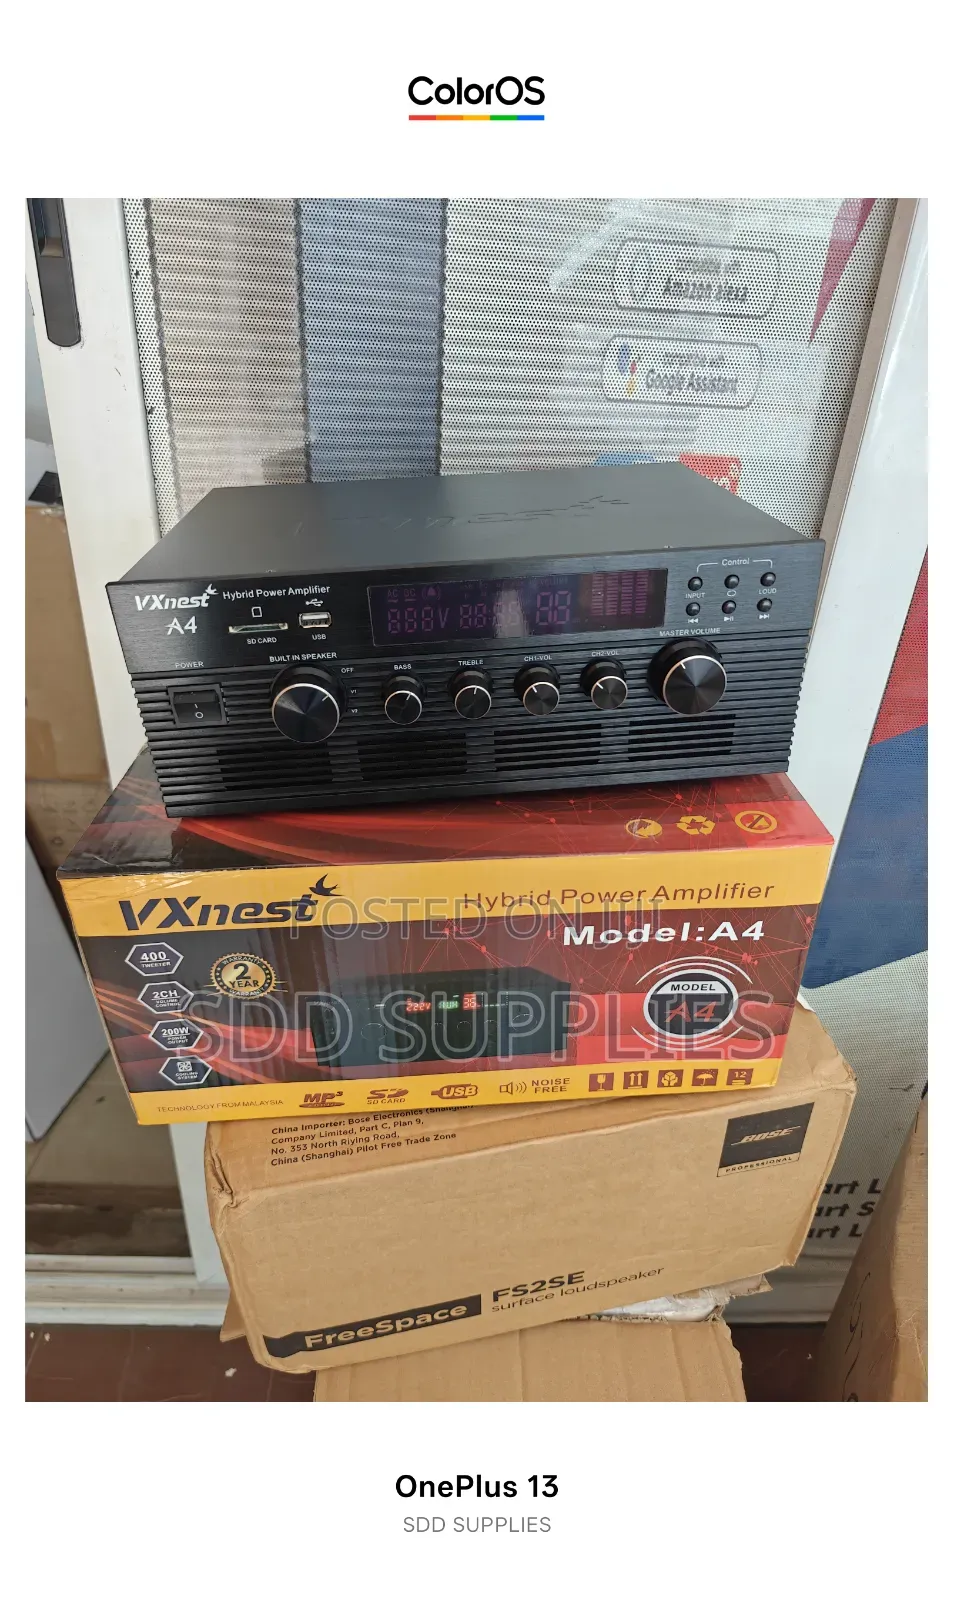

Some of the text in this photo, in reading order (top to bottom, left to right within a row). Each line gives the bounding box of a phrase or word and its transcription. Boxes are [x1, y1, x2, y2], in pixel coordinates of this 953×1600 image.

[645, 368, 738, 395] Google Assistant
[722, 558, 750, 566] Control
[222, 585, 330, 601] Hybrid Power Amplifier
[135, 593, 210, 610] VXnest
[165, 615, 198, 635] A4
[660, 627, 721, 637] MASTER VOLUME
[175, 661, 204, 669] POWER
[269, 655, 291, 663] BUILT
[302, 652, 338, 660] SPEAKER
[464, 883, 774, 912] Hybrid Power Amplifier
[119, 894, 318, 931] VXnest
[141, 951, 167, 961] 400
[222, 956, 261, 965] WARRANTY
[233, 962, 251, 980] 2
[229, 980, 260, 988] YEAR
[670, 983, 716, 991] MODEL
[152, 990, 178, 999] 2CH
[161, 1026, 189, 1036] 200W
[531, 1077, 571, 1087] NOISE
[534, 1085, 567, 1093] FREE
[442, 1085, 478, 1098] USB
[157, 1099, 284, 1112] TECHNOLOGY FROM MALAYSIA
[381, 1097, 406, 1105] CARD
[271, 1125, 298, 1136] China
[301, 1119, 346, 1133] Importer:
[348, 1116, 371, 1126] Bose
[373, 1108, 424, 1121] Electronics
[271, 1117, 424, 1147] Company Limited, Part C, Plan 9,
[737, 1127, 796, 1144] BOSE
[271, 1146, 287, 1156] No.
[290, 1143, 308, 1153] 353
[311, 1138, 338, 1150] North
[373, 1130, 401, 1141] Road,
[271, 1131, 457, 1167] China (Shanghai) Pilot Free Trade Zone
[725, 1156, 792, 1173] PROFESSIONAL
[491, 1267, 666, 1313] surface loudspeaker
[492, 1270, 586, 1303] FS2SE
[304, 1304, 468, 1349] FreeSpace
